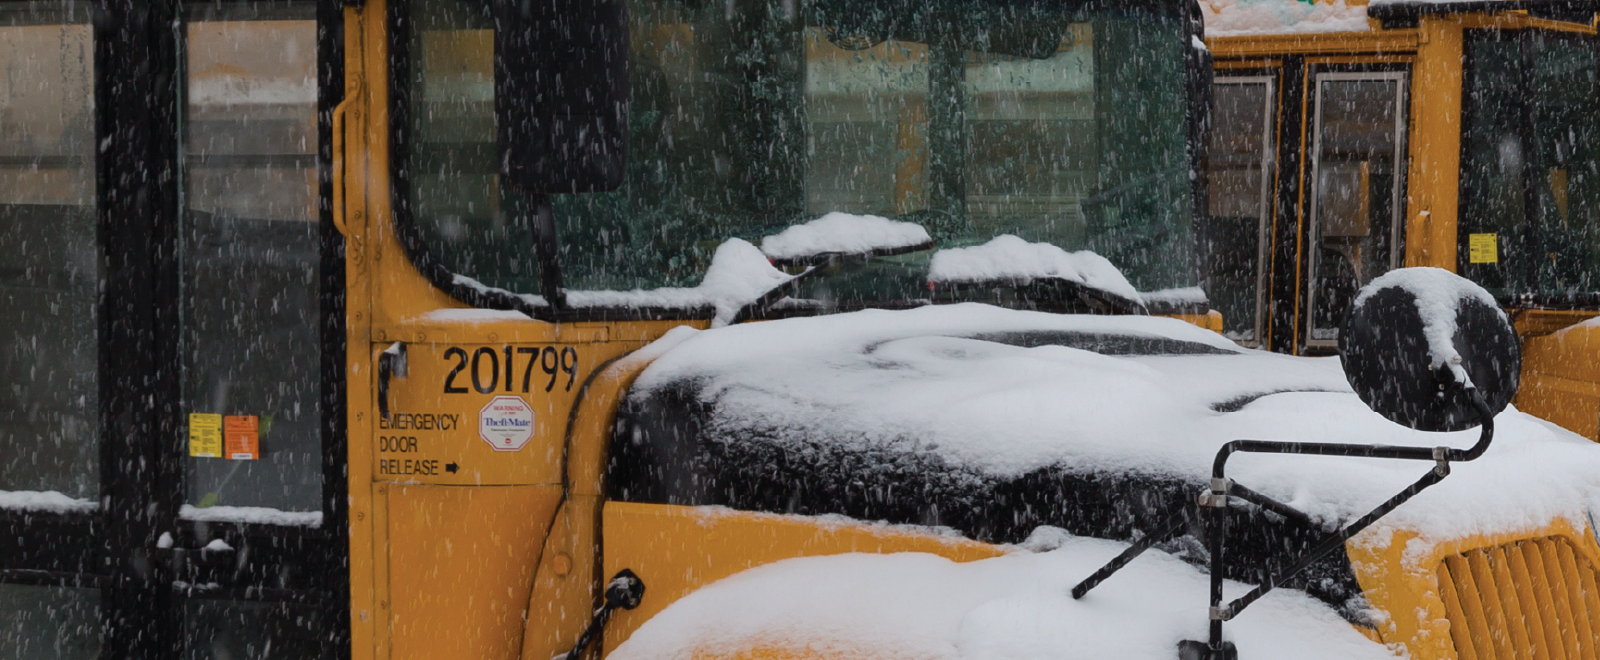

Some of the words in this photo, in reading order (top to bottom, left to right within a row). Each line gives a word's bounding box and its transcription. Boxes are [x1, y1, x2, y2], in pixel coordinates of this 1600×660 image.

[443, 345, 578, 394] 201799
[379, 413, 459, 431] EMERGENCY
[379, 436, 418, 453] DOOR
[379, 459, 439, 476] RELEASE
